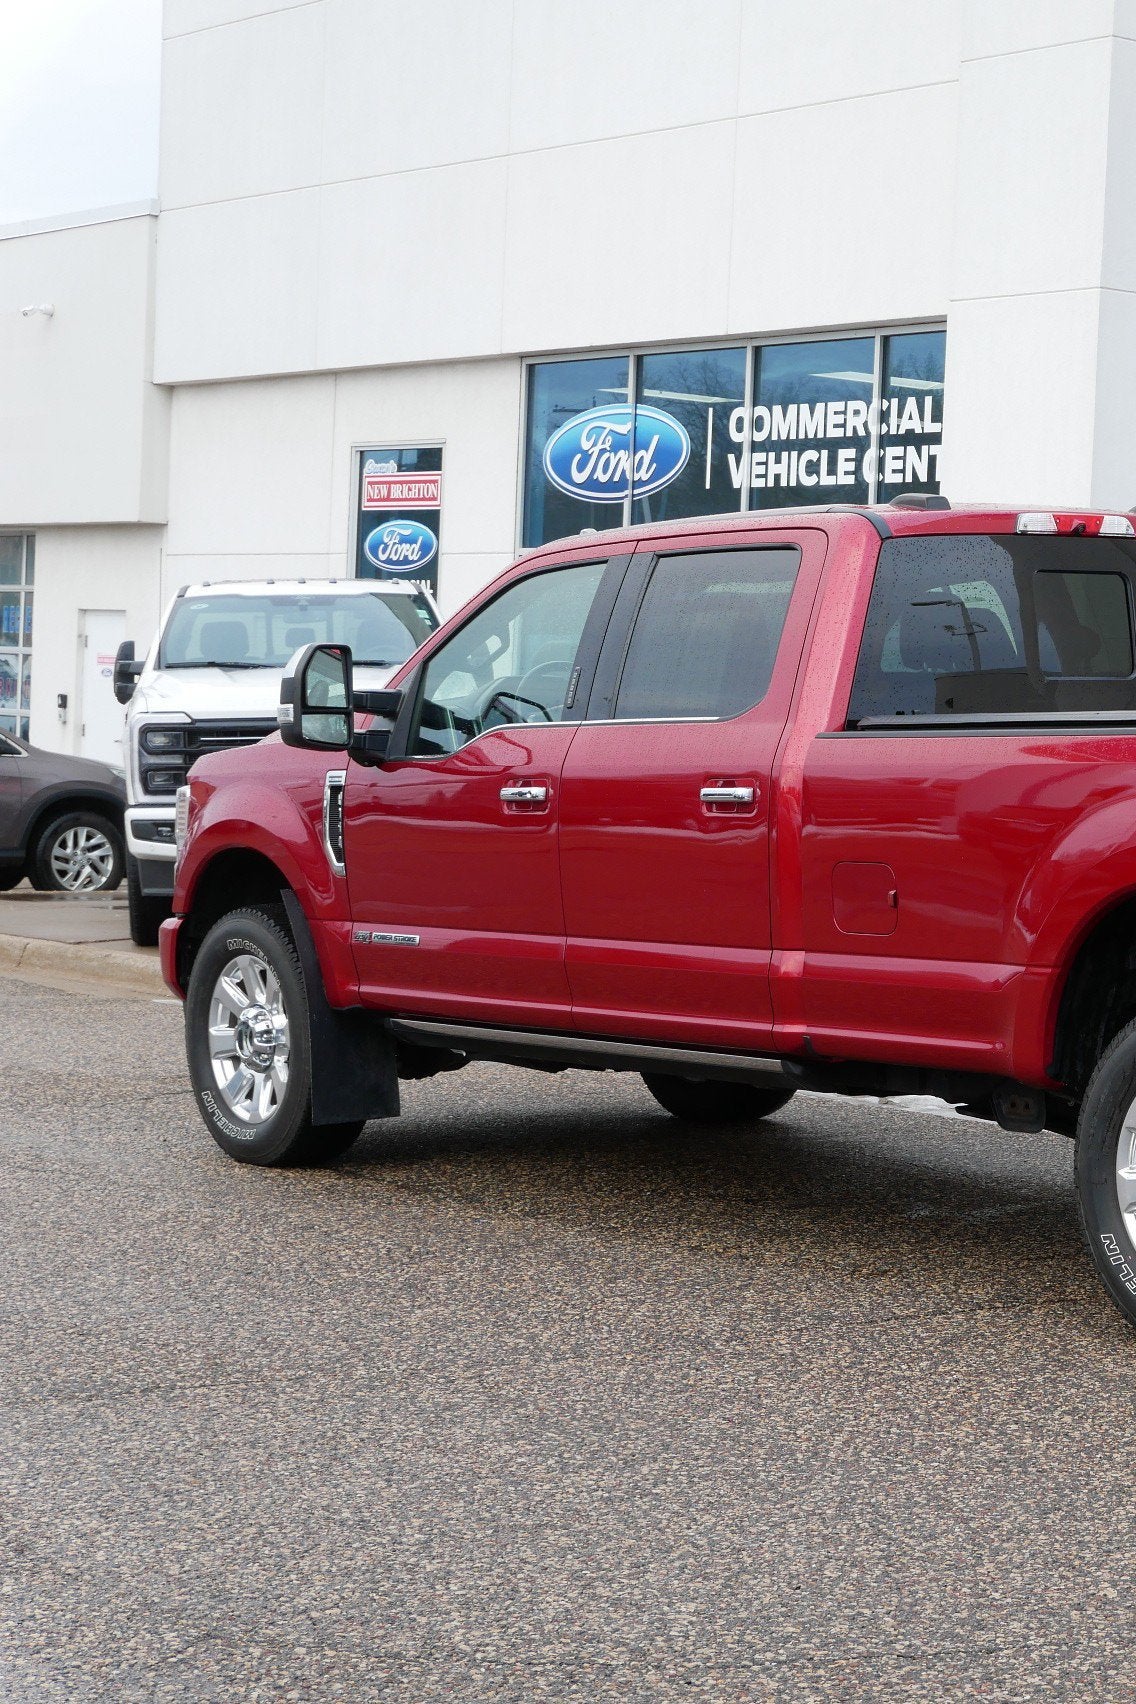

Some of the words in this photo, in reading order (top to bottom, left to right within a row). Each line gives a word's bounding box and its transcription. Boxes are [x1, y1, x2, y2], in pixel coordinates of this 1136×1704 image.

[728, 396, 942, 443] COMMERCIAL
[571, 421, 660, 484] Ford
[727, 448, 857, 489] VEHICLE
[367, 484, 389, 500] NEW
[390, 482, 438, 499] BRIGHTON
[378, 527, 424, 561] Ford
[373, 933, 393, 942] POWER
[393, 935, 417, 943] STROKE
[201, 1090, 257, 1140] MICHELIN
